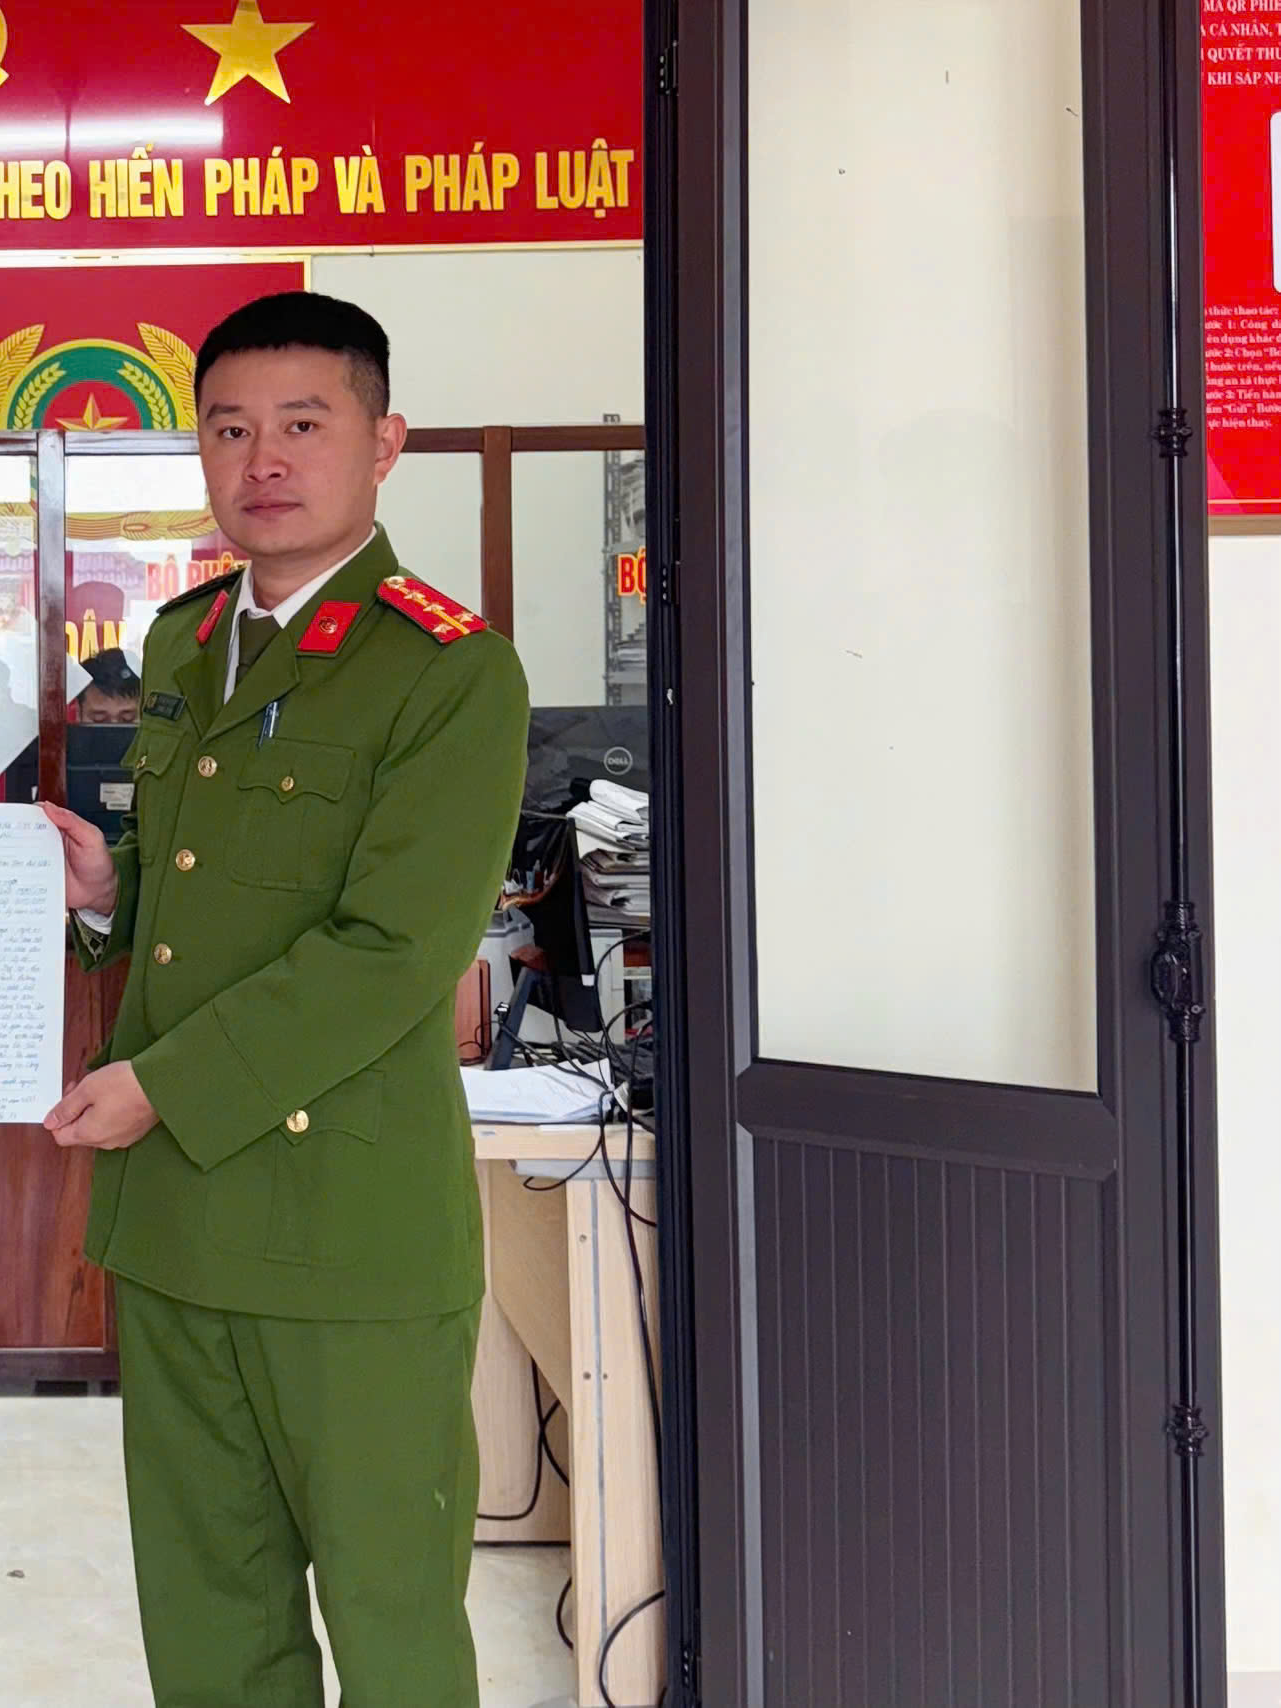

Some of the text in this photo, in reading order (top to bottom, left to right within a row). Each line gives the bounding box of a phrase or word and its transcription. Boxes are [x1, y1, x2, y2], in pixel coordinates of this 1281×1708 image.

[1226, 0, 1247, 14] QR
[1207, 71, 1232, 86] KHI
[89, 143, 184, 218] HIẾN
[204, 145, 319, 216] PHÁP
[334, 144, 386, 215] VÀ
[405, 142, 520, 212] PHÁP
[536, 137, 635, 219] LUẬT
